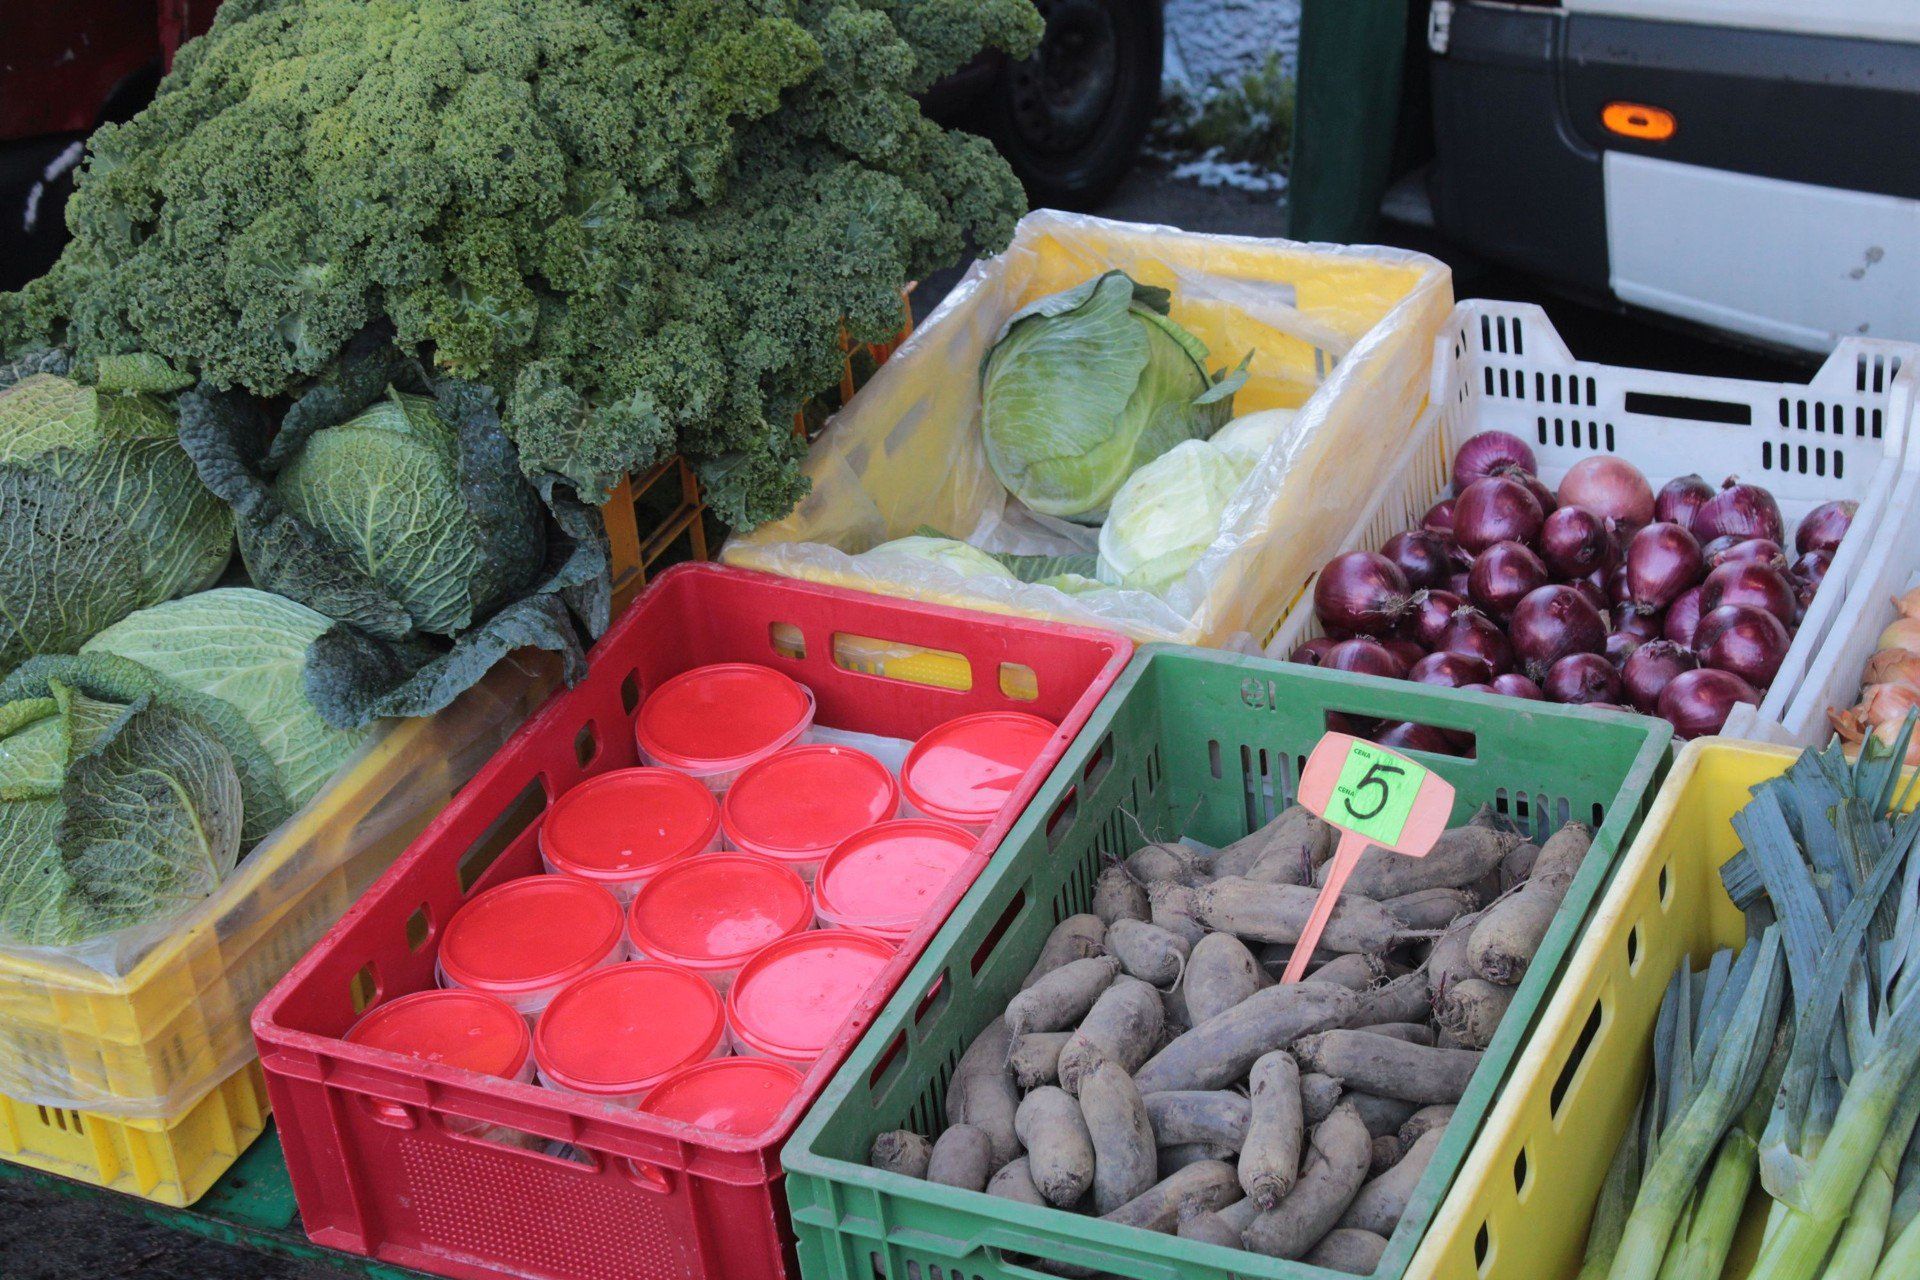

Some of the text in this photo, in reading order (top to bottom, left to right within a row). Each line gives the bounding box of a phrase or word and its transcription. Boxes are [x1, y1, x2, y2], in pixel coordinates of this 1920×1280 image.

[1353, 748, 1371, 759] CENA
[1337, 785, 1355, 797] CENA
[1344, 763, 1405, 820] 5
